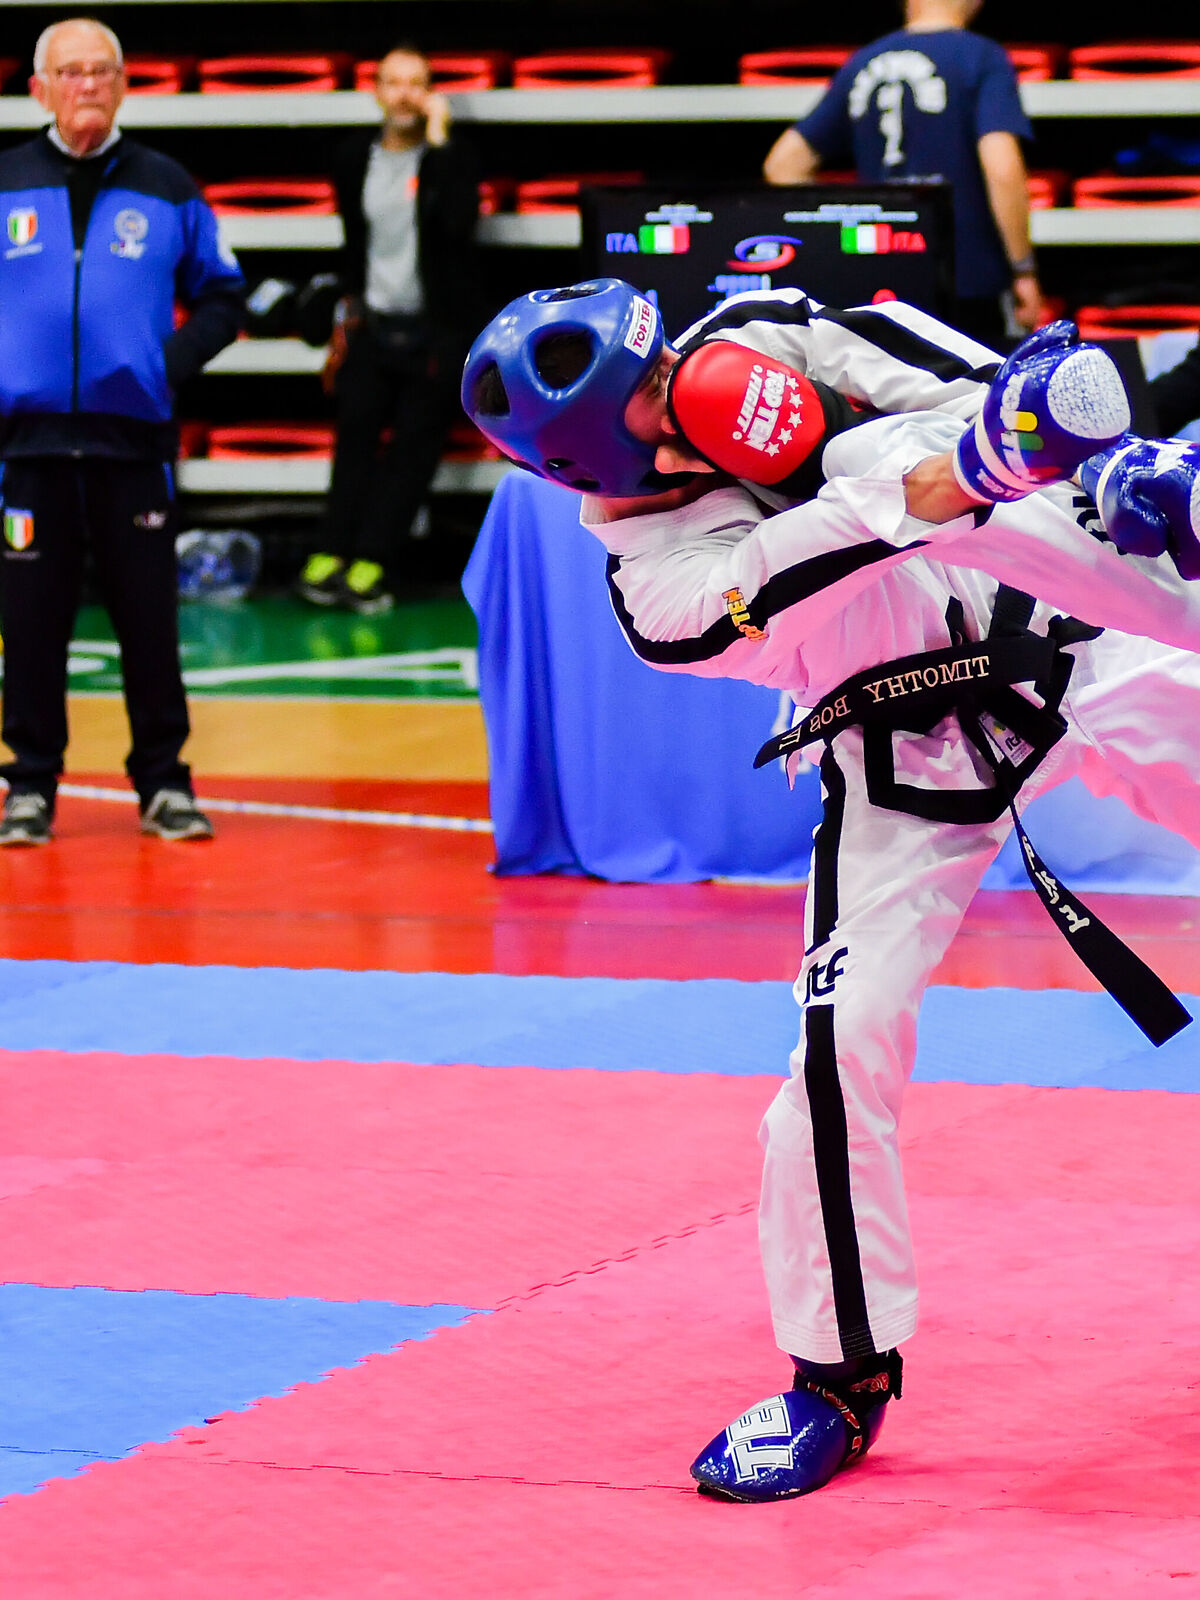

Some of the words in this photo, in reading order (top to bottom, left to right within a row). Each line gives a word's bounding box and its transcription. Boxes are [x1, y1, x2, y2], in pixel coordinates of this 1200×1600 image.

[606, 232, 639, 254] ITA
[891, 231, 927, 252] ITA
[633, 325, 649, 349] TOP
[762, 368, 787, 409] TOP
[743, 405, 780, 452] TEN
[722, 587, 751, 628] TEN
